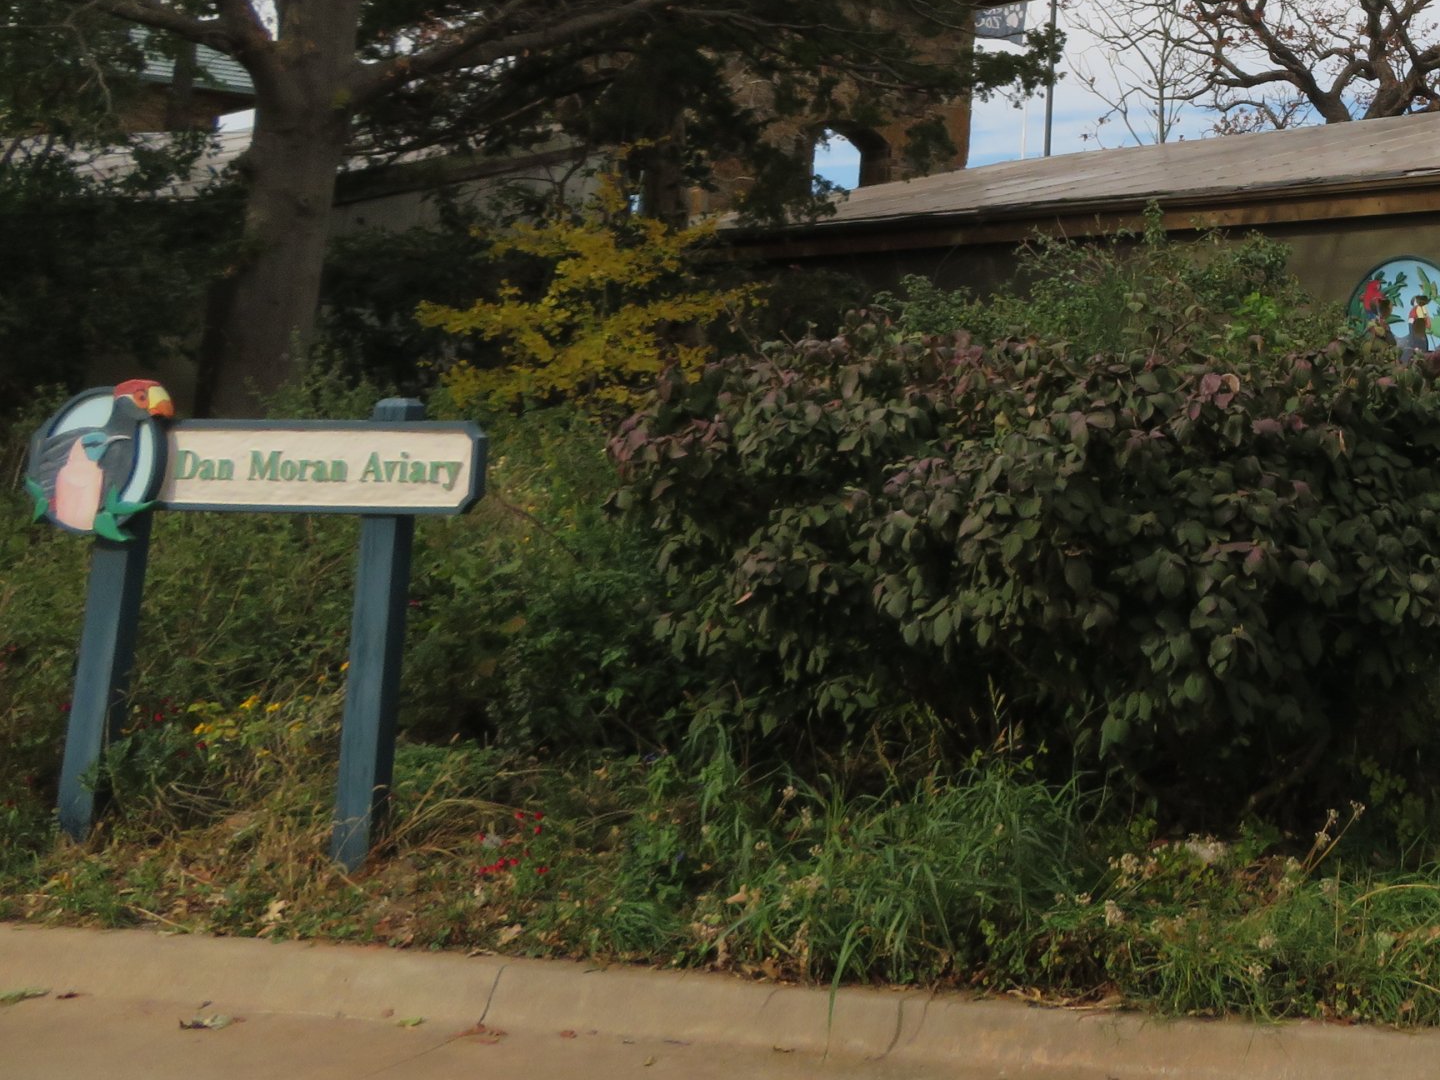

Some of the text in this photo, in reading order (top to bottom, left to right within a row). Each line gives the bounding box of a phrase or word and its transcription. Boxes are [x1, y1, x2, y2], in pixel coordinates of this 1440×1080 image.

[174, 449, 464, 492] Dan Moran Aviary
